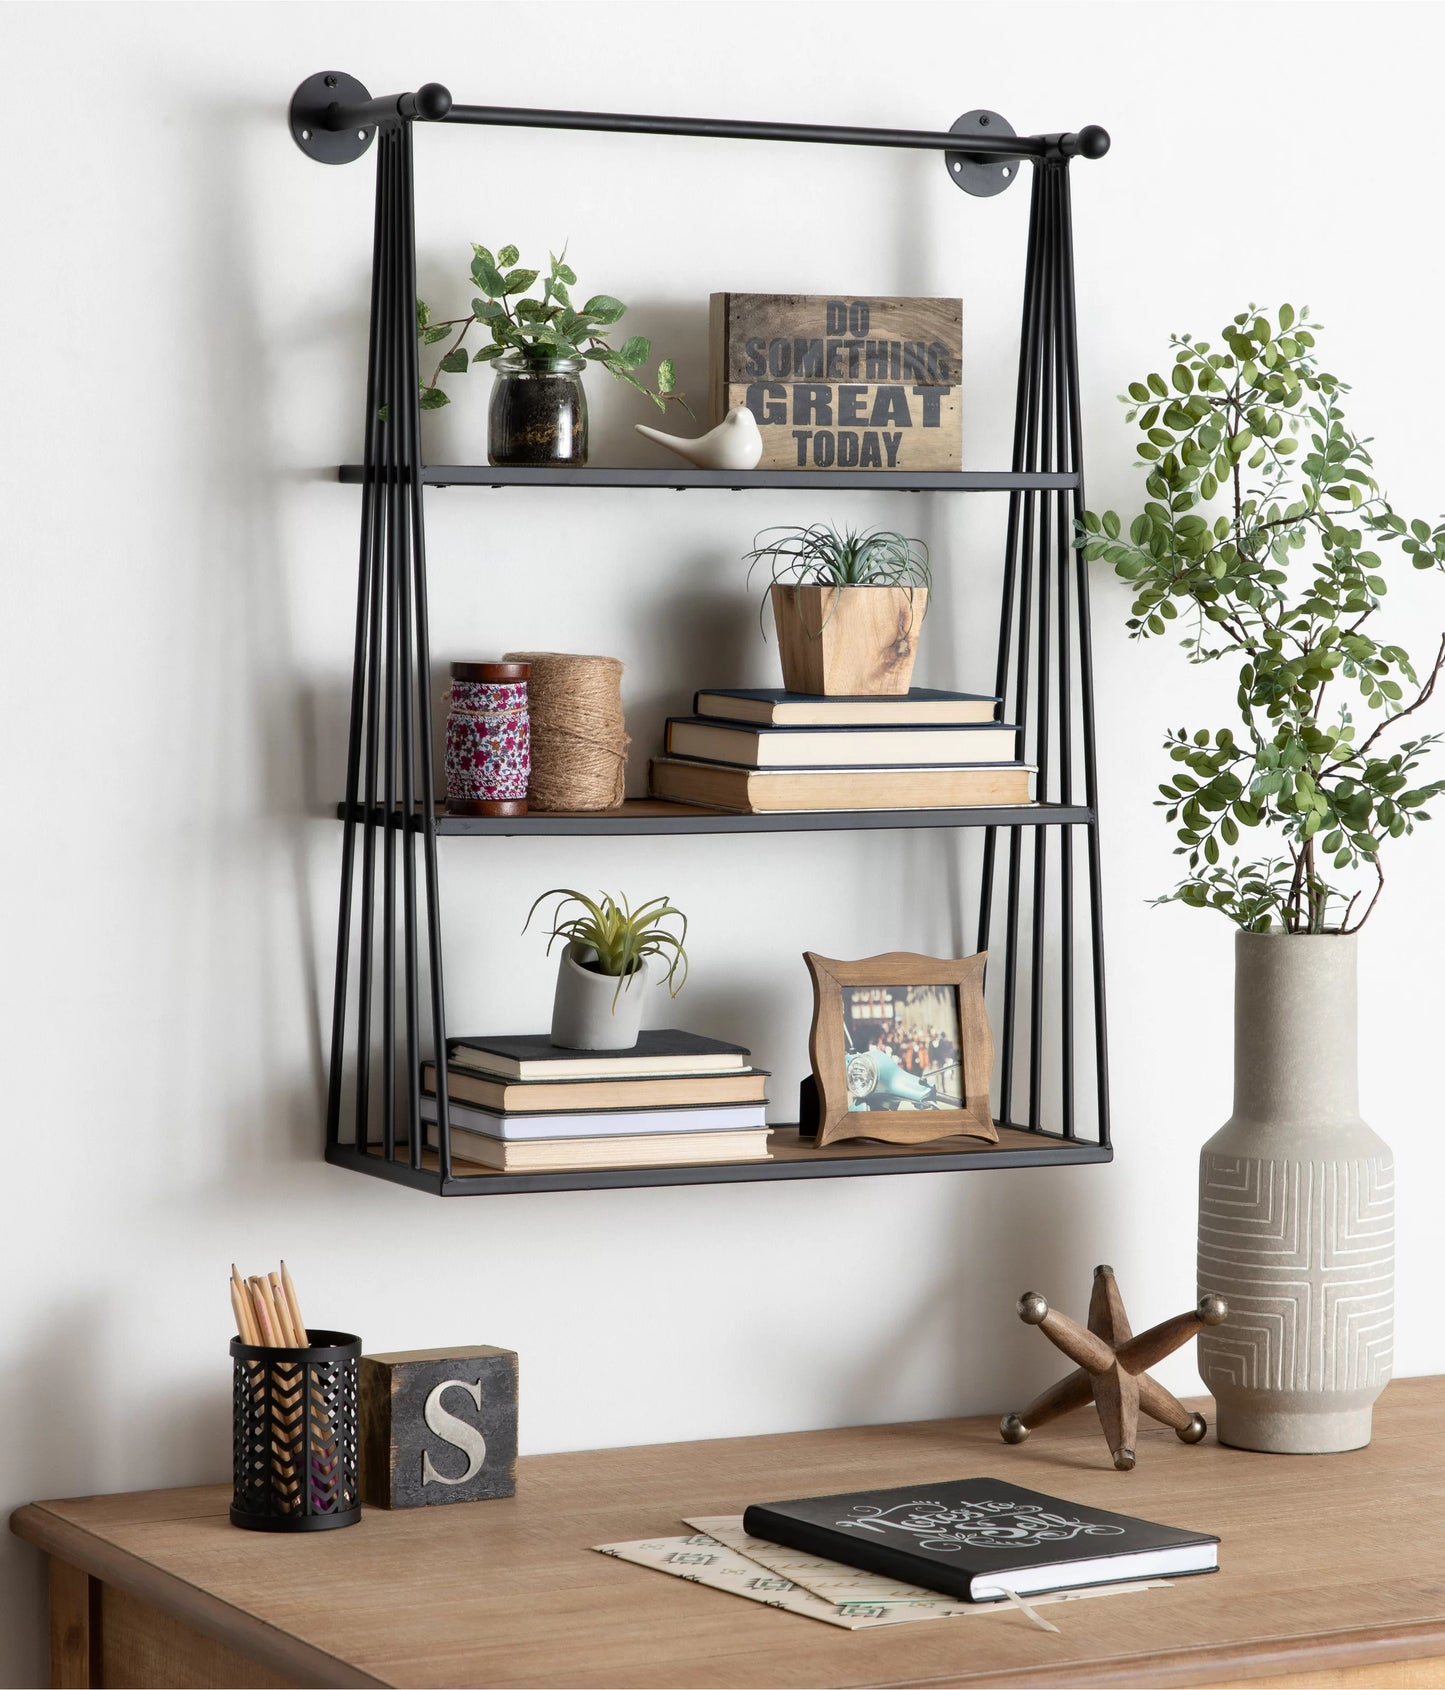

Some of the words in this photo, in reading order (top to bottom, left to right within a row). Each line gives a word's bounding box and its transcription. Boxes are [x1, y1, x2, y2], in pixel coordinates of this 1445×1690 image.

[826, 300, 870, 338] DO
[745, 337, 950, 381] SOMETHING
[746, 383, 951, 428] GREAT
[792, 430, 903, 468] TODAY
[421, 1378, 487, 1487] S
[835, 1502, 985, 1534] Notes
[960, 1500, 1017, 1513] to
[955, 1513, 1118, 1541] Self
